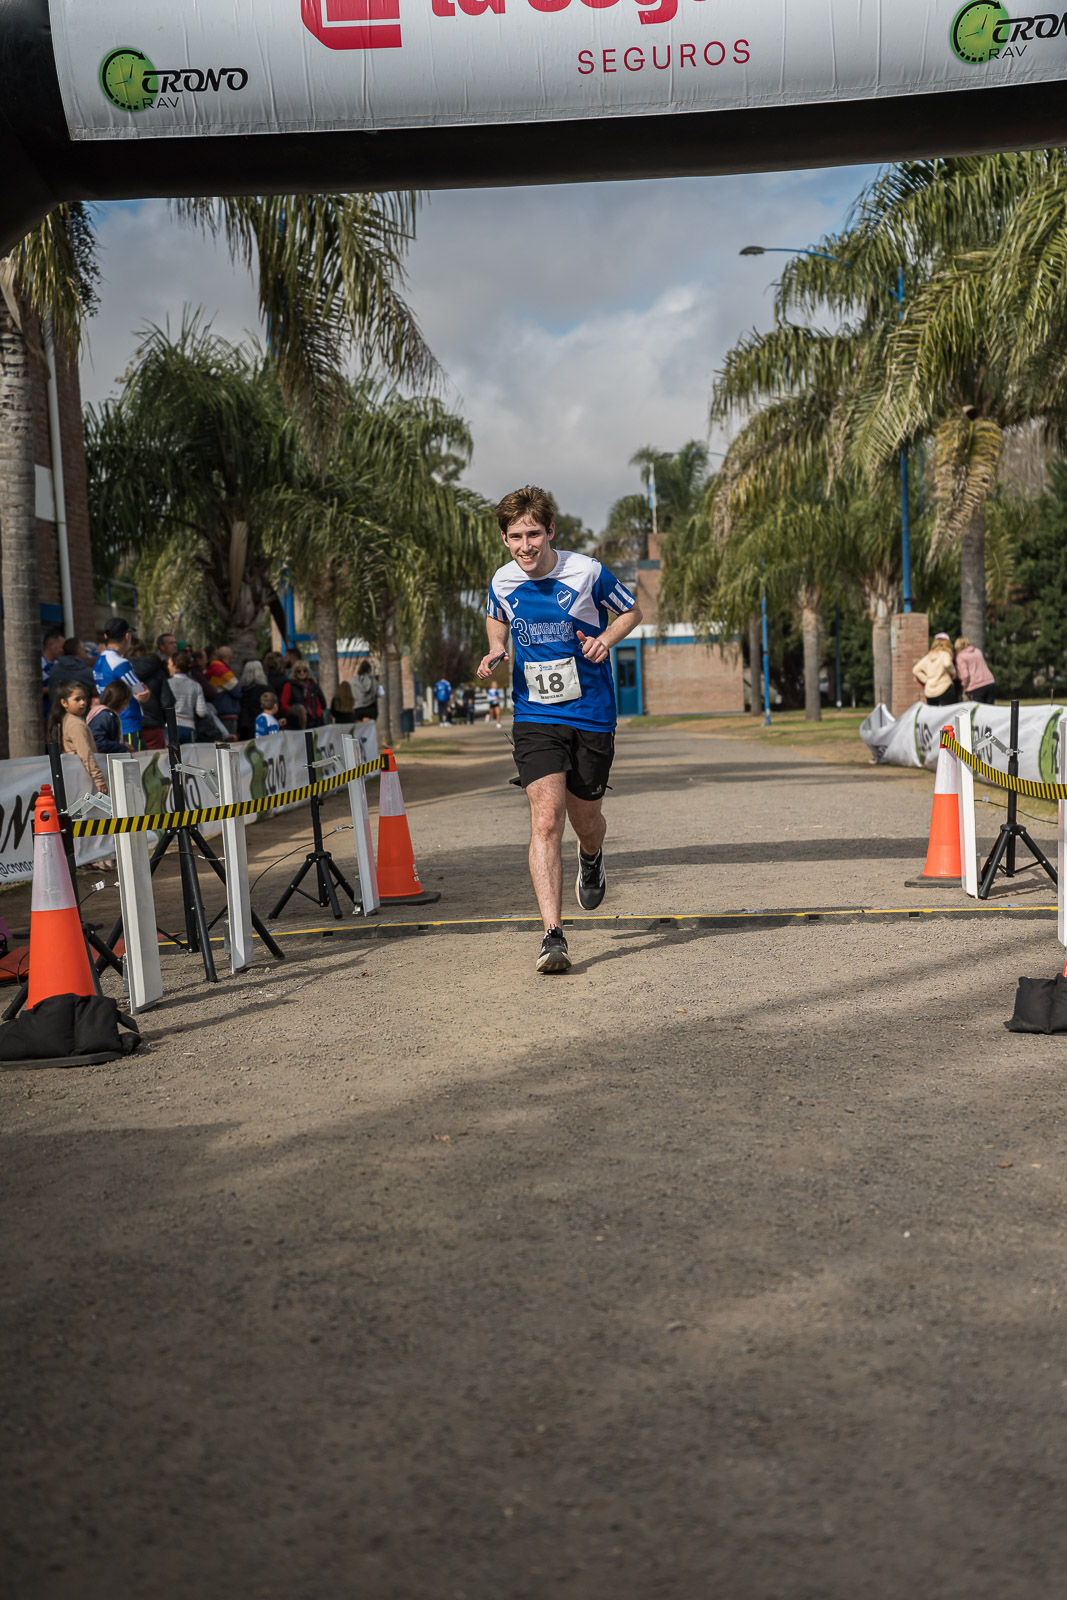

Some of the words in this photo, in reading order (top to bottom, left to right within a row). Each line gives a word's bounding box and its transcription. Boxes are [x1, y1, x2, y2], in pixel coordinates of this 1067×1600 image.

[577, 38, 751, 75] SEGUROS
[988, 45, 1028, 61] RAV
[141, 67, 248, 93] CRONO
[141, 96, 179, 109] RAV
[512, 617, 531, 647] 3
[535, 672, 564, 694] 18
